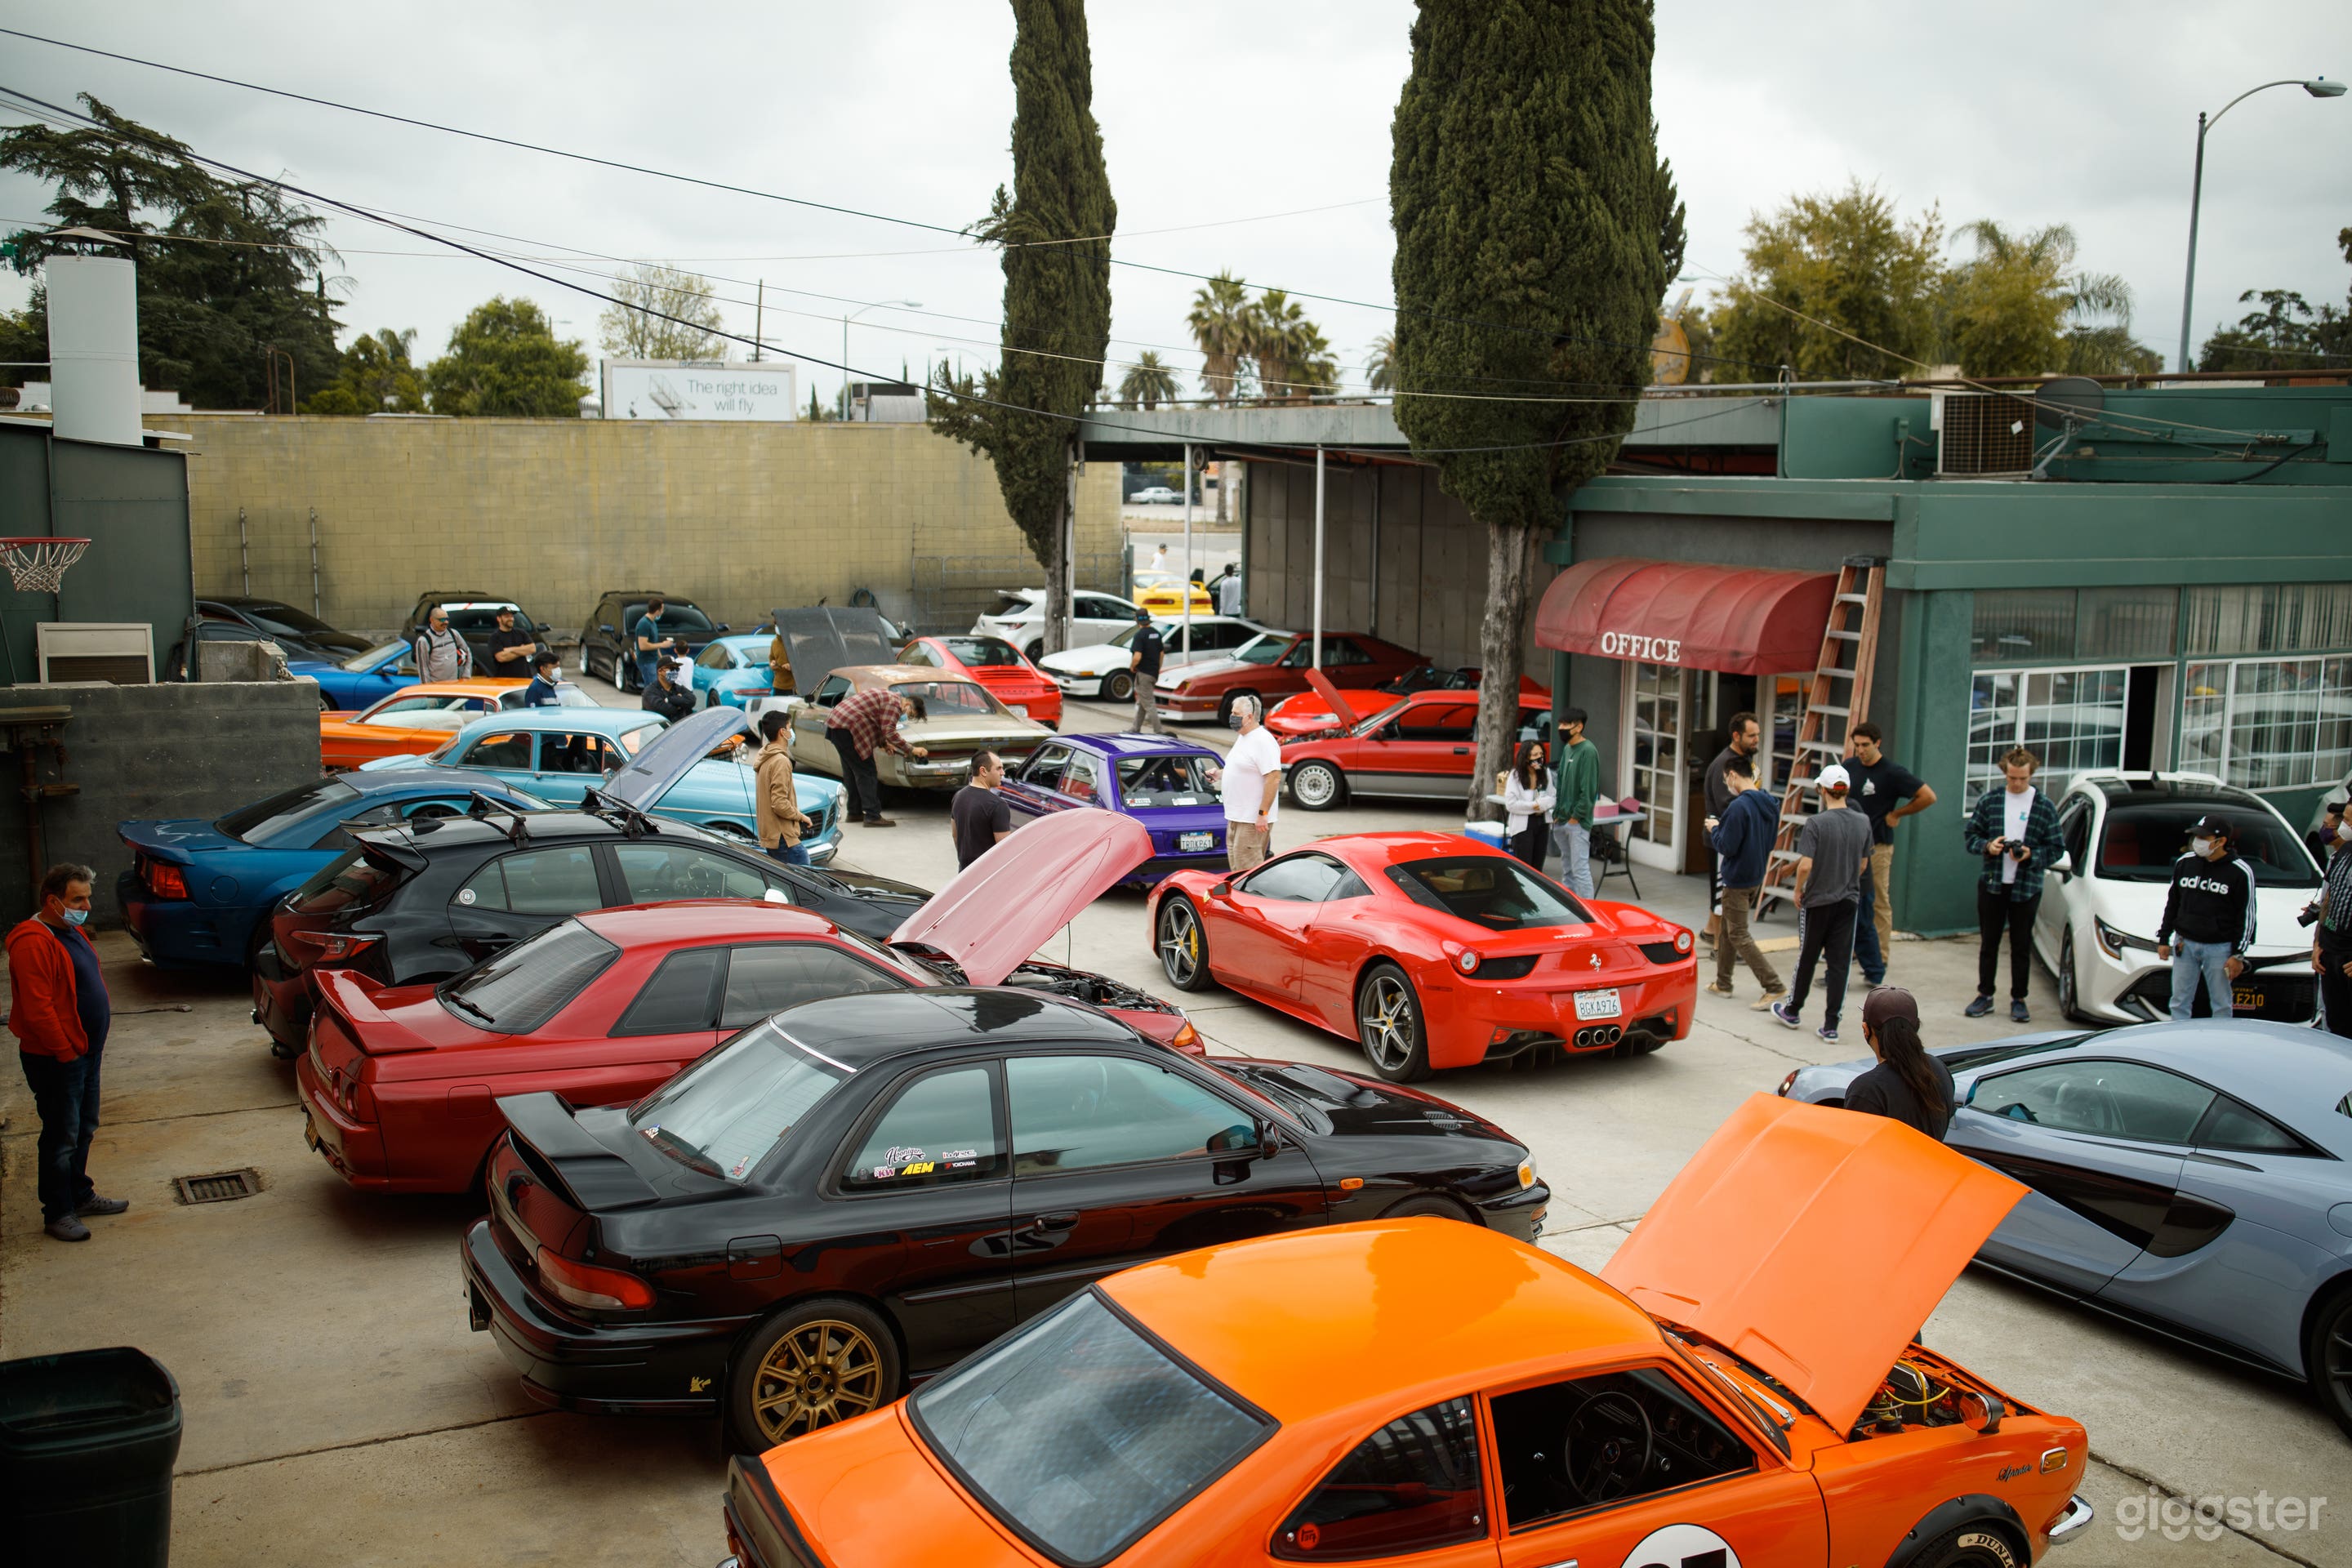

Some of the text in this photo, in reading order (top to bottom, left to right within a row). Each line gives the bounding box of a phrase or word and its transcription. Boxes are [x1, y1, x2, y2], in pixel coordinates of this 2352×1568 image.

[687, 379, 777, 397] The right idea
[714, 398, 735, 412] will
[1601, 631, 1681, 662] OFFICE
[1579, 1000, 1618, 1015] 8GKA976
[885, 1147, 925, 1167] Hoonigan
[952, 1160, 977, 1168] YOKOHAMA
[878, 1168, 896, 1178] KW
[902, 1161, 936, 1175] AEM
